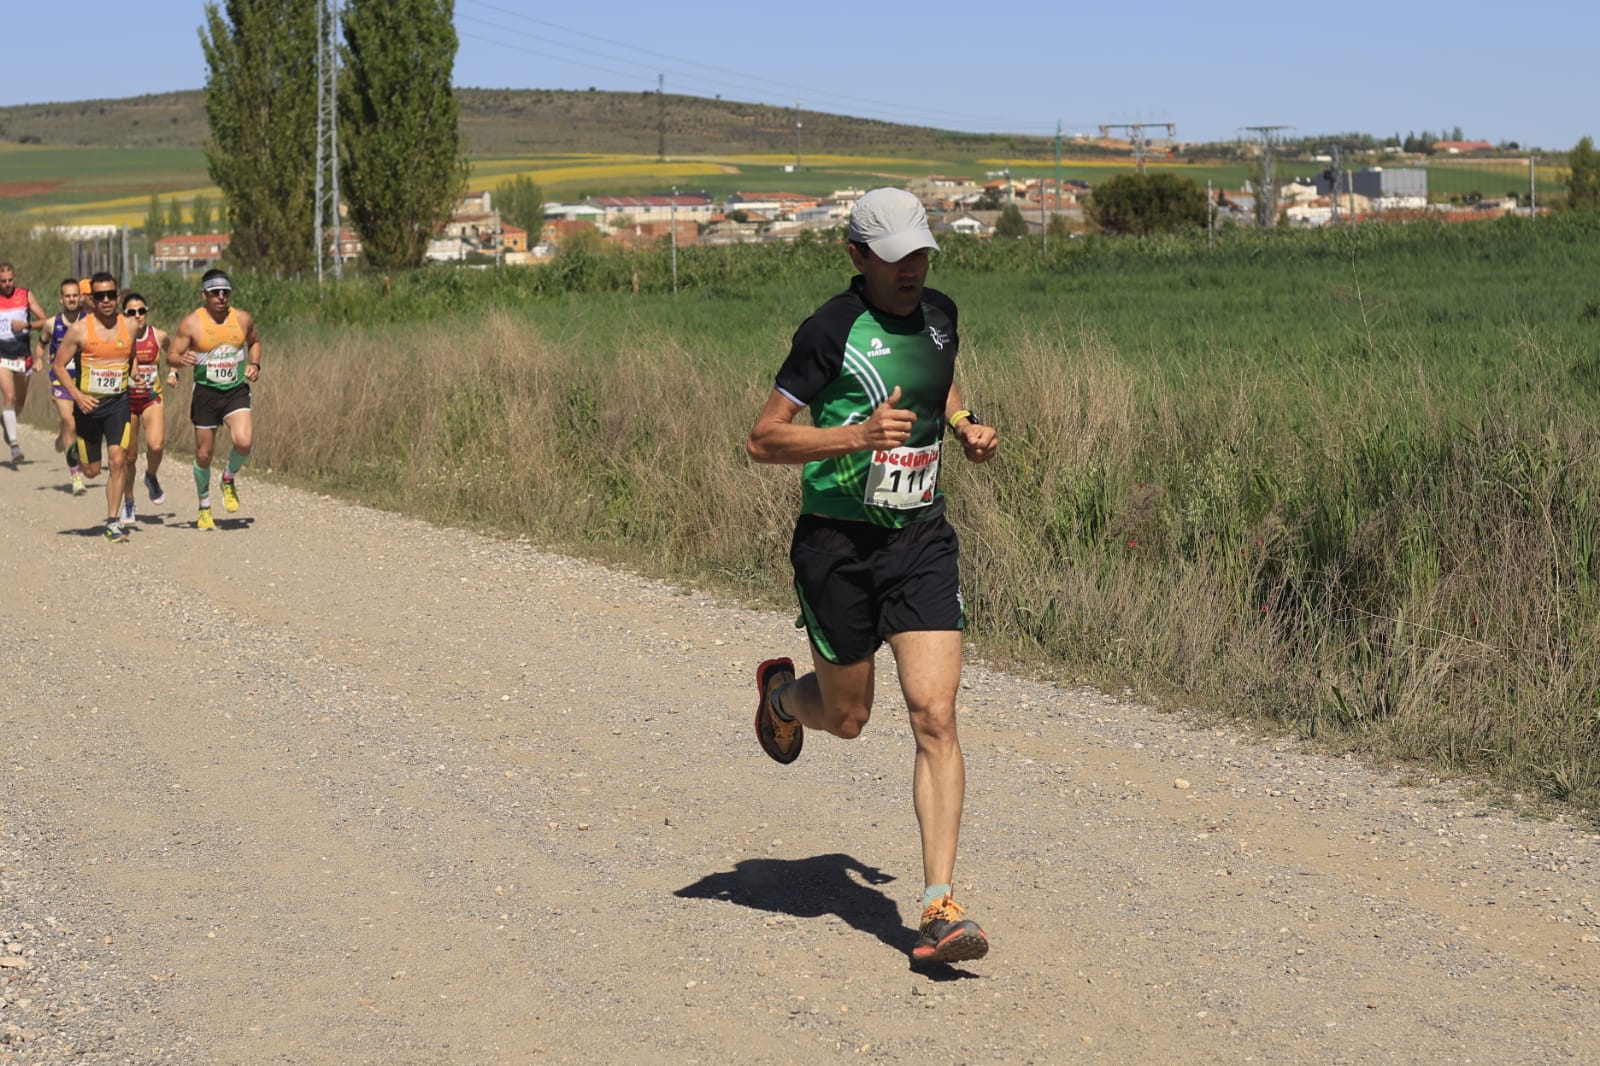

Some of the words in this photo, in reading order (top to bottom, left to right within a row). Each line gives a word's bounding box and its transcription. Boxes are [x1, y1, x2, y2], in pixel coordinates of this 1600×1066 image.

[214, 368, 233, 378] 106
[96, 377, 116, 387] 128
[889, 468, 926, 494] 111
